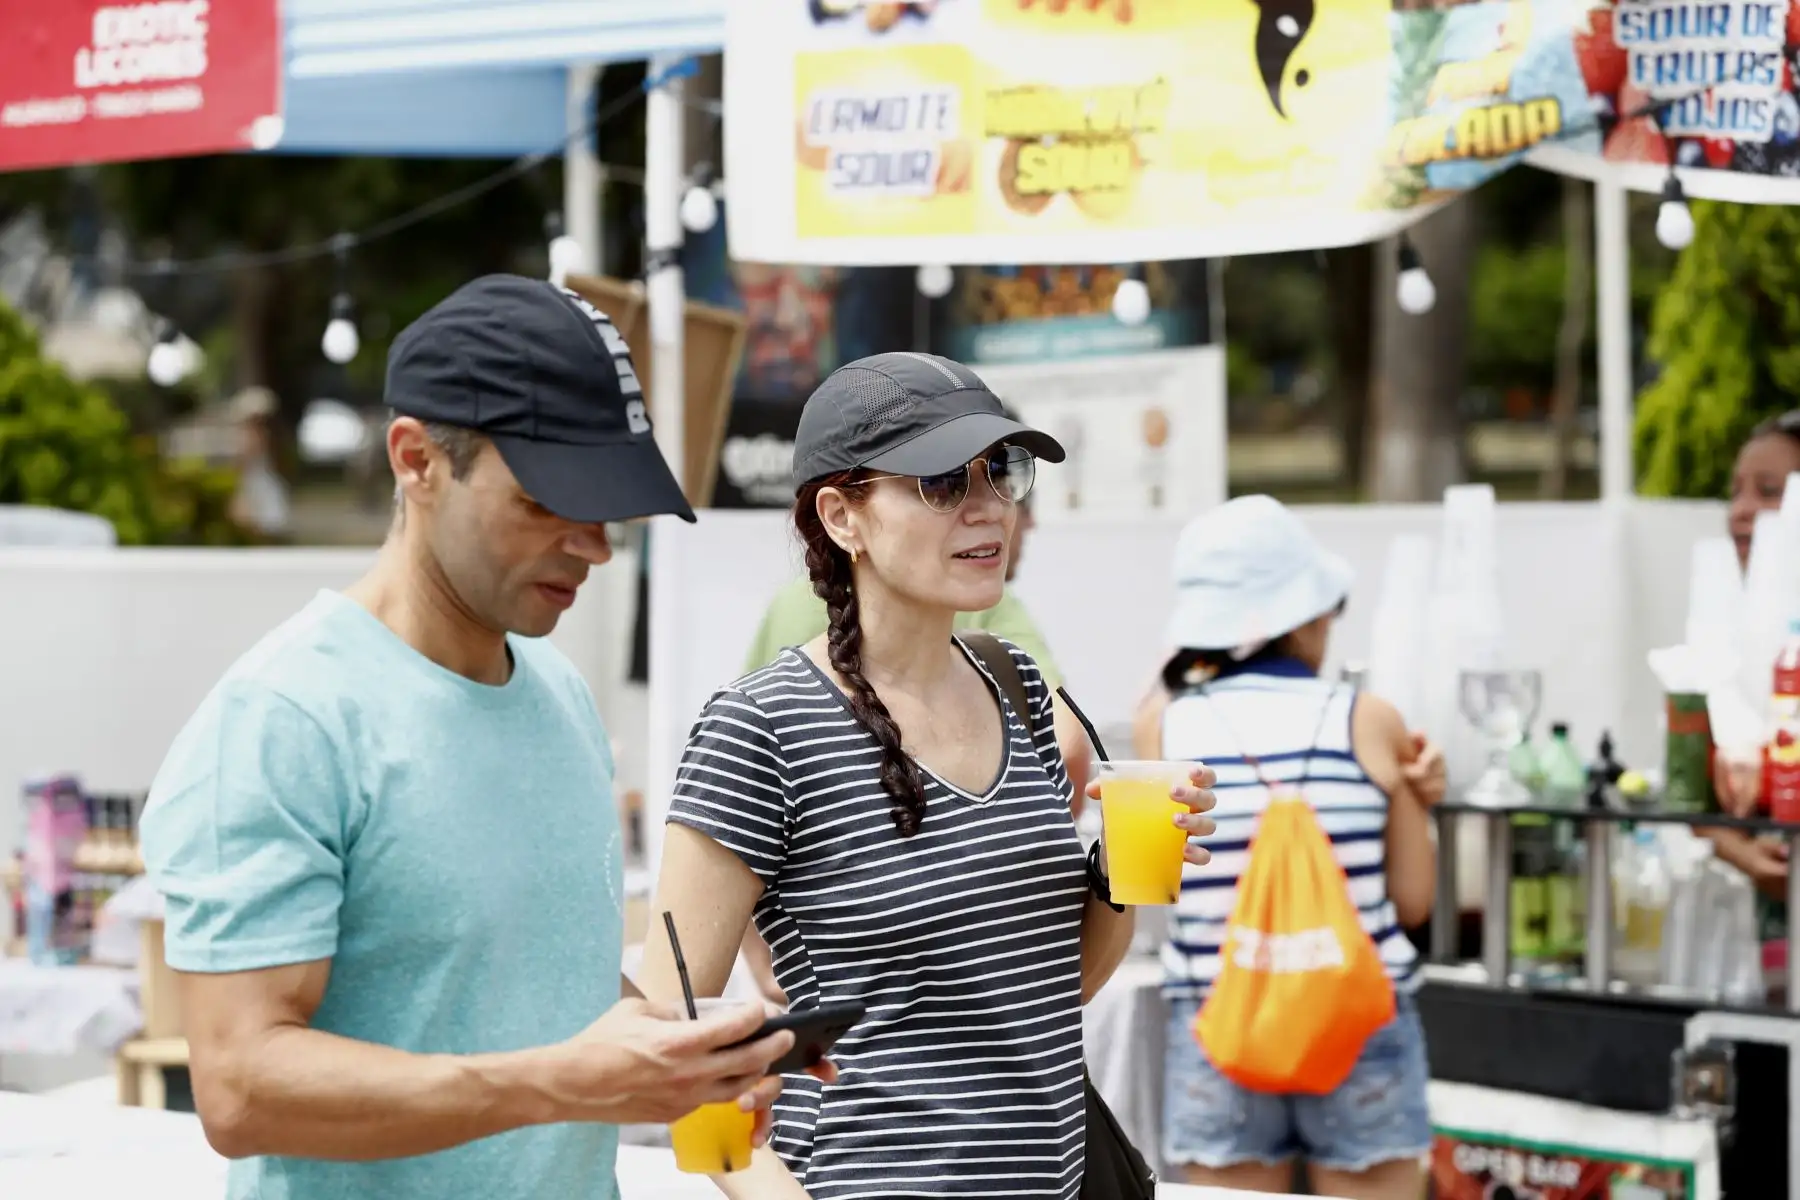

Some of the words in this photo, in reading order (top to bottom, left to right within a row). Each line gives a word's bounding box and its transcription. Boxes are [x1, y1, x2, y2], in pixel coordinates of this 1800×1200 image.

[1618, 4, 1731, 42] SOUR
[1742, 3, 1785, 38] DE
[1633, 50, 1779, 84] FRUTAS
[832, 150, 932, 188] SOUR
[559, 287, 650, 434] RUNN
